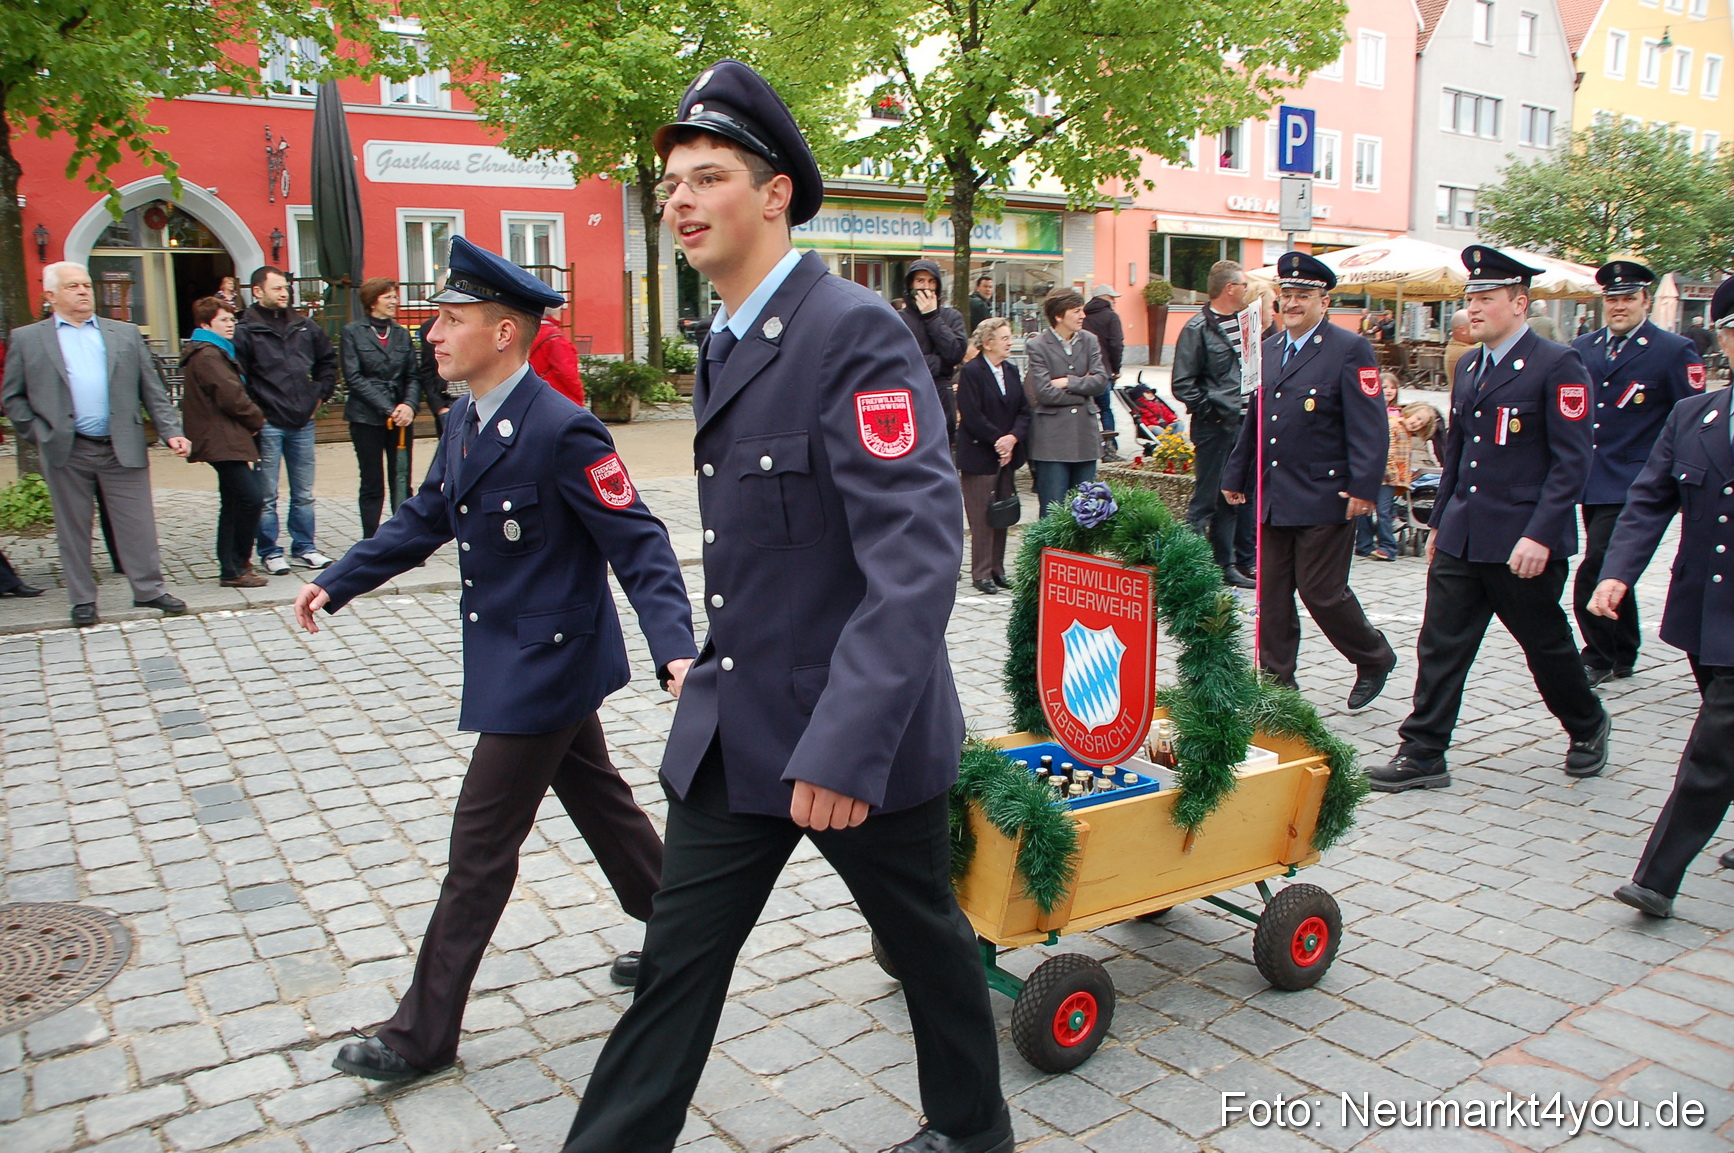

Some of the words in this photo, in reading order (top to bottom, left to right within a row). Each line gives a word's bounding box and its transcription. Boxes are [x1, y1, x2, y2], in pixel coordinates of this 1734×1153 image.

[1285, 114, 1309, 165] P
[376, 149, 461, 176] Gasthaus
[466, 153, 567, 180] Ehrnsberger
[588, 213, 603, 227] 19
[791, 213, 933, 237] enmöbelschau
[1350, 270, 1410, 283] Weissbier
[861, 395, 906, 405] FREIWILLIGE
[862, 403, 907, 412] FEUERWEHR
[1048, 562, 1143, 599] FREIWILLIGE
[1048, 583, 1142, 622] FEUERWEHR
[1046, 688, 1135, 754] LABERSRICHT
